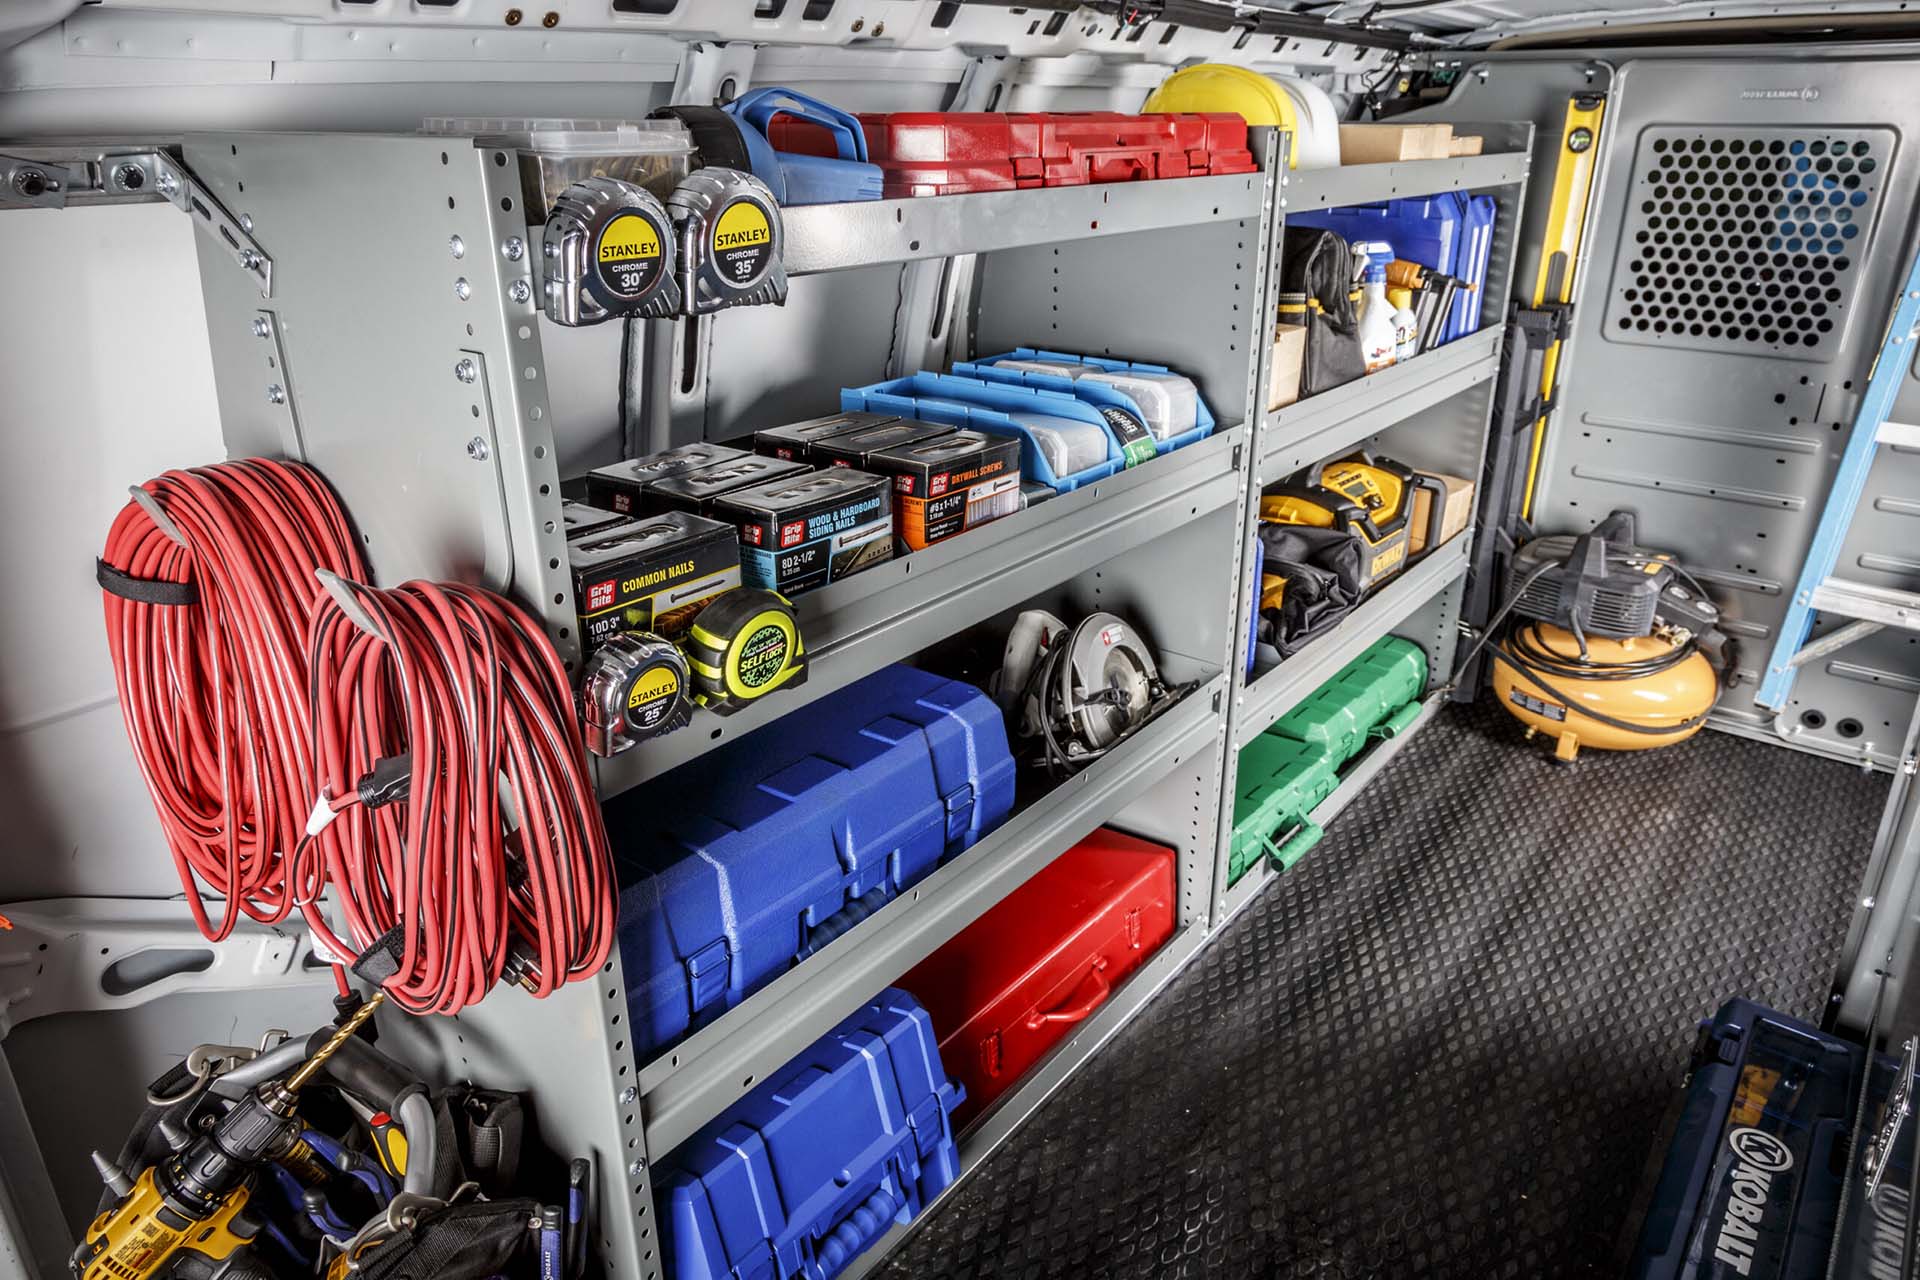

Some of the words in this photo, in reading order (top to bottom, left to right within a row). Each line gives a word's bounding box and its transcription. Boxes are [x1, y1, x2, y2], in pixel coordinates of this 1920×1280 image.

[716, 228, 766, 247] STANLEY
[602, 242, 656, 258] STANLEY
[726, 248, 759, 261] CHROME
[612, 262, 648, 272] CHROME
[951, 468, 978, 485] DRYWALL
[979, 460, 1004, 477] SCREWS
[808, 513, 832, 529] WOOD
[832, 511, 839, 522] &
[840, 498, 881, 518] HARDBOARD
[784, 524, 802, 535] Grip
[808, 523, 834, 540] SIDING
[835, 516, 856, 533] NAILS
[782, 557, 793, 570] 8D
[622, 569, 666, 594] COMMON
[668, 560, 695, 580] NAILS
[590, 583, 613, 598] Grip
[590, 594, 612, 609] Rite
[590, 620, 609, 636] 10D
[631, 682, 675, 705] STANLEY
[638, 698, 668, 713] CHROME
[1714, 1162, 1773, 1276] KOBALT
